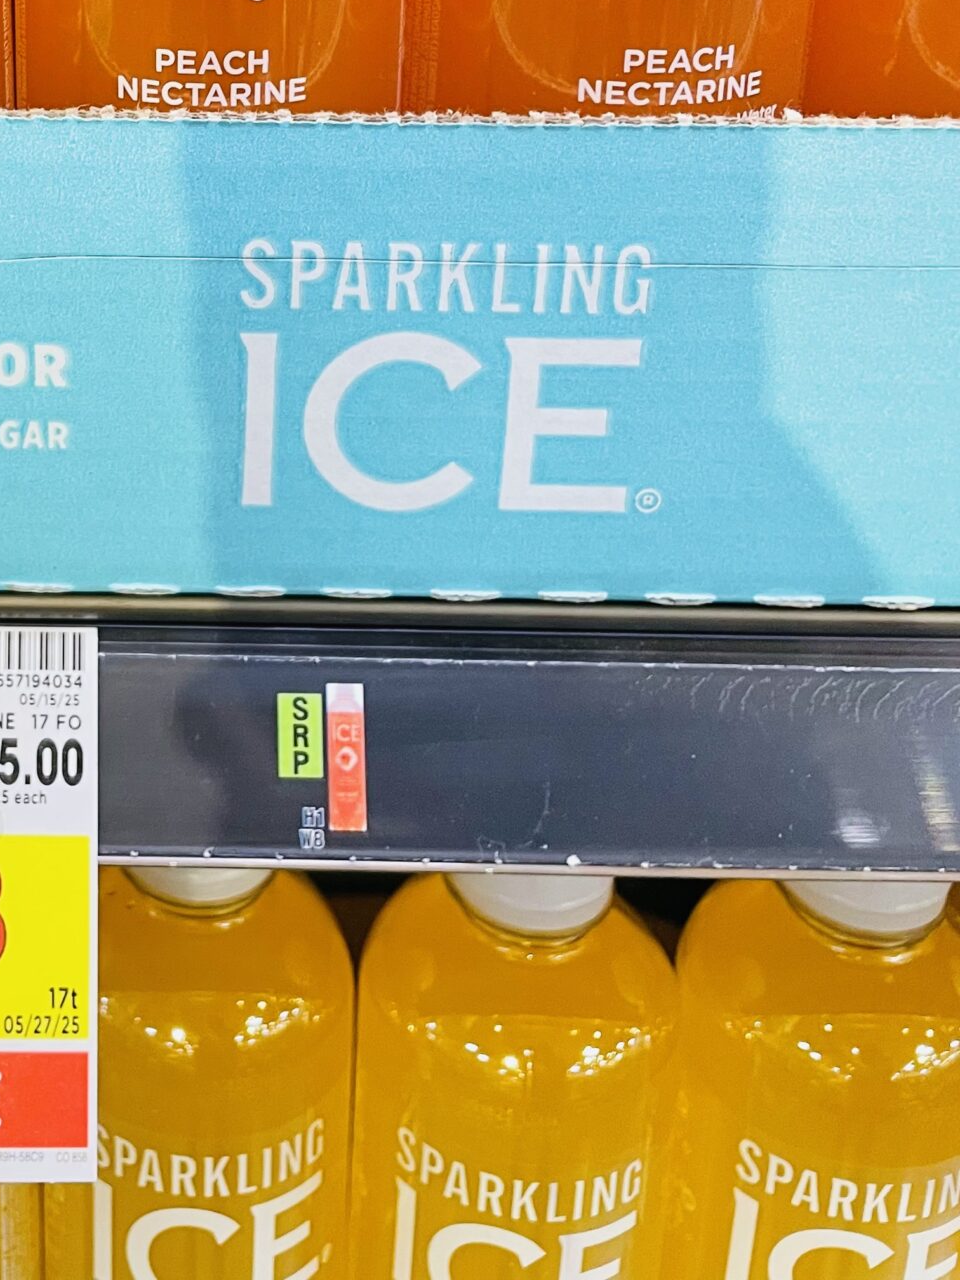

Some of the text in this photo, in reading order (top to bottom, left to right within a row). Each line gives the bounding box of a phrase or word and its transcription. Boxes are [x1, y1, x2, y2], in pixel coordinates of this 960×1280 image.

[155, 47, 270, 76] PEACH
[622, 44, 737, 74] PEACH
[116, 75, 307, 108] NECTARINE
[576, 69, 763, 106] NECTARINE
[239, 237, 653, 316] SPARKLING
[239, 330, 643, 513] ICE
[19, 693, 80, 707] 05/15/25
[32, 714, 48, 730] 17
[56, 715, 82, 731] FO
[14, 791, 47, 805] each
[48, 987, 78, 1009] 17t
[3, 1015, 80, 1037] 05/27/25
[97, 1118, 325, 1198] SPARKLING
[396, 1126, 643, 1223] SPARKLING
[736, 1138, 960, 1223] SPARKLIN
